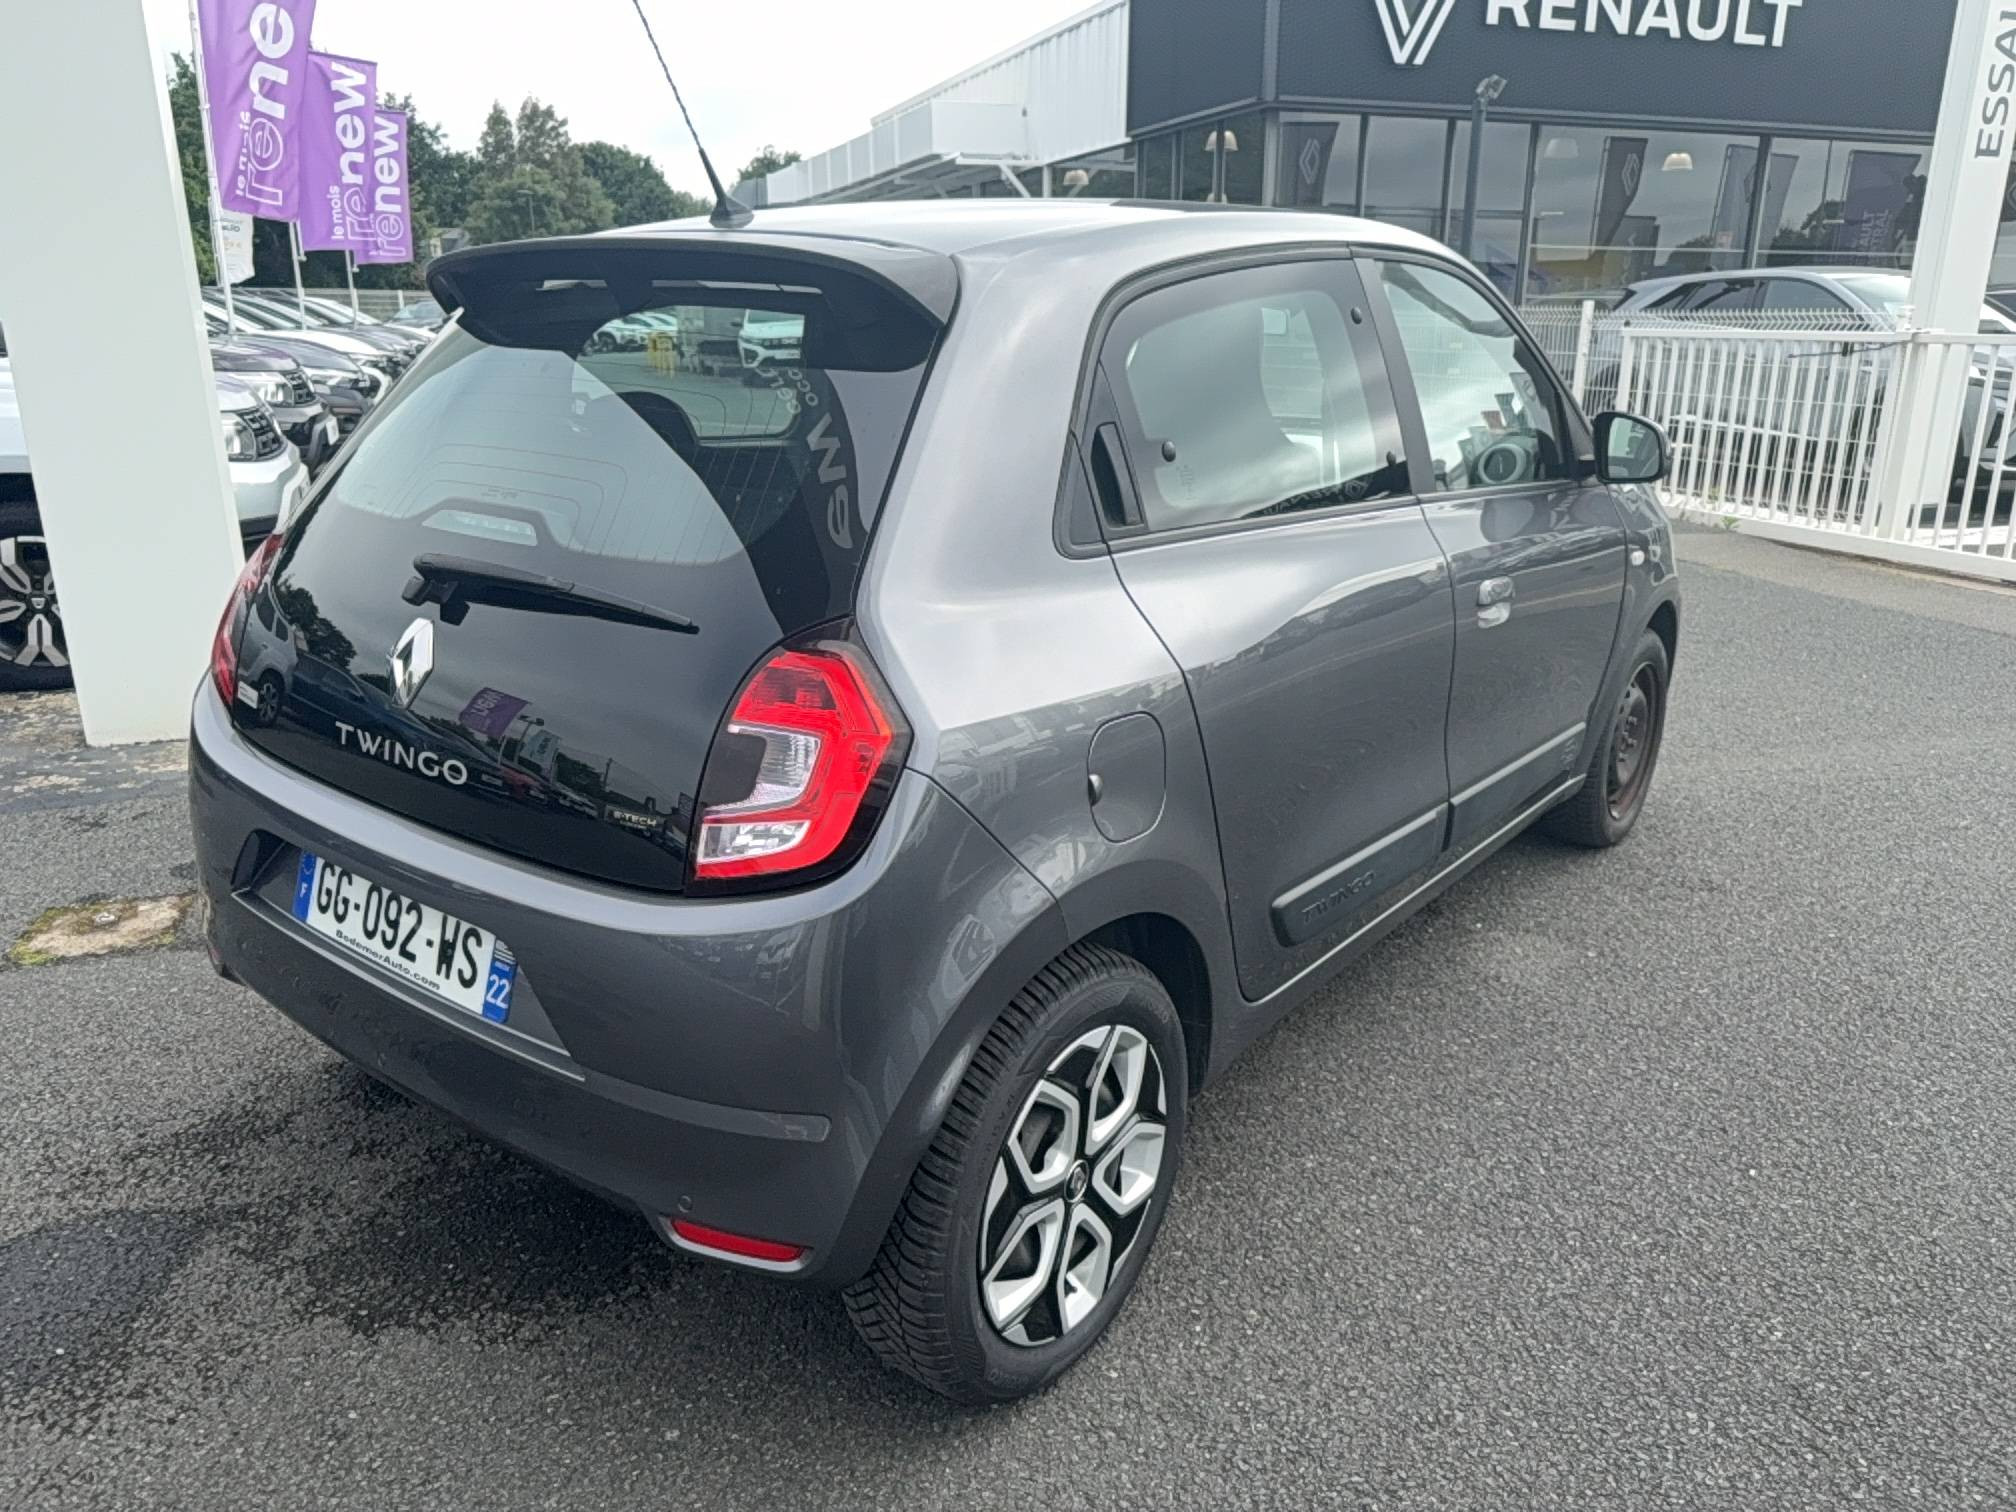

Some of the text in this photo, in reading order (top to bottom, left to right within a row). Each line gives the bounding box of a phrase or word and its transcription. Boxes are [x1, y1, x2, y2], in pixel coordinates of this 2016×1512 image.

[330, 61, 374, 241] renew
[327, 185, 345, 240] le mois
[372, 116, 407, 257] renew
[336, 720, 468, 786] TWINGO
[299, 883, 308, 898] F
[317, 861, 483, 989] GG-092-WS
[336, 928, 441, 991] BodemerAuto.com
[485, 973, 512, 1009] 22
